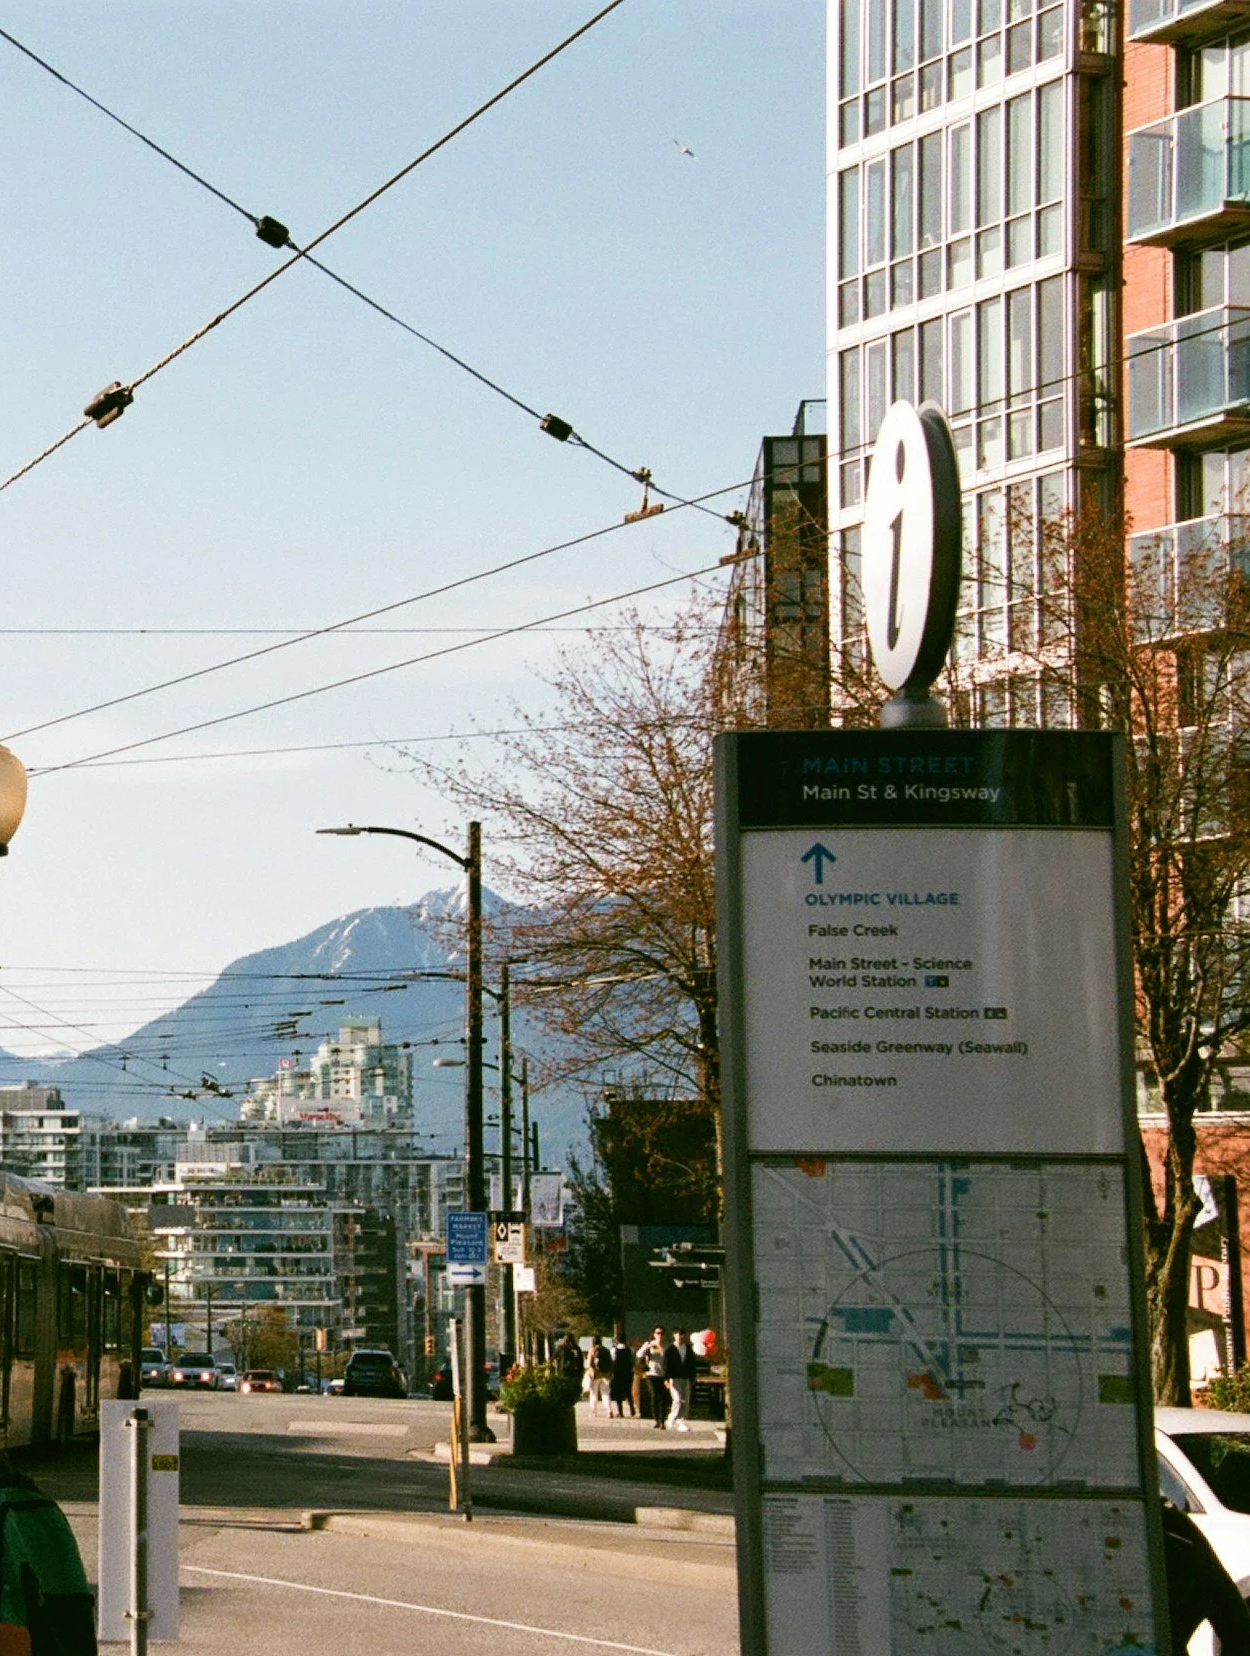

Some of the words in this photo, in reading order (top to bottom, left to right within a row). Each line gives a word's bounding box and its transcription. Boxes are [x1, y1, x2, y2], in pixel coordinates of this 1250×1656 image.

[802, 757, 868, 774] MAIN
[878, 757, 975, 774] STREET
[803, 785, 851, 800] Main
[857, 785, 878, 800] St
[884, 785, 898, 799] &
[904, 784, 1001, 803] Kingsway
[805, 893, 881, 906] OLYMPIC
[886, 893, 960, 906] VILLAGE
[808, 924, 849, 937] False
[852, 924, 899, 937] Creek
[809, 957, 846, 971] Main
[850, 957, 898, 971] Street
[912, 957, 973, 971] Science
[809, 975, 857, 988] World
[861, 975, 917, 988] Station
[809, 1006, 860, 1020] Pacific
[864, 1006, 920, 1020] Central
[924, 1006, 979, 1020] Station
[811, 1041, 872, 1054] Seaside
[876, 1041, 954, 1056] Greenway
[958, 1041, 1029, 1056] (Seawall)
[811, 1074, 897, 1087] Chinatown
[921, 1417, 993, 1428] PLEASAN
